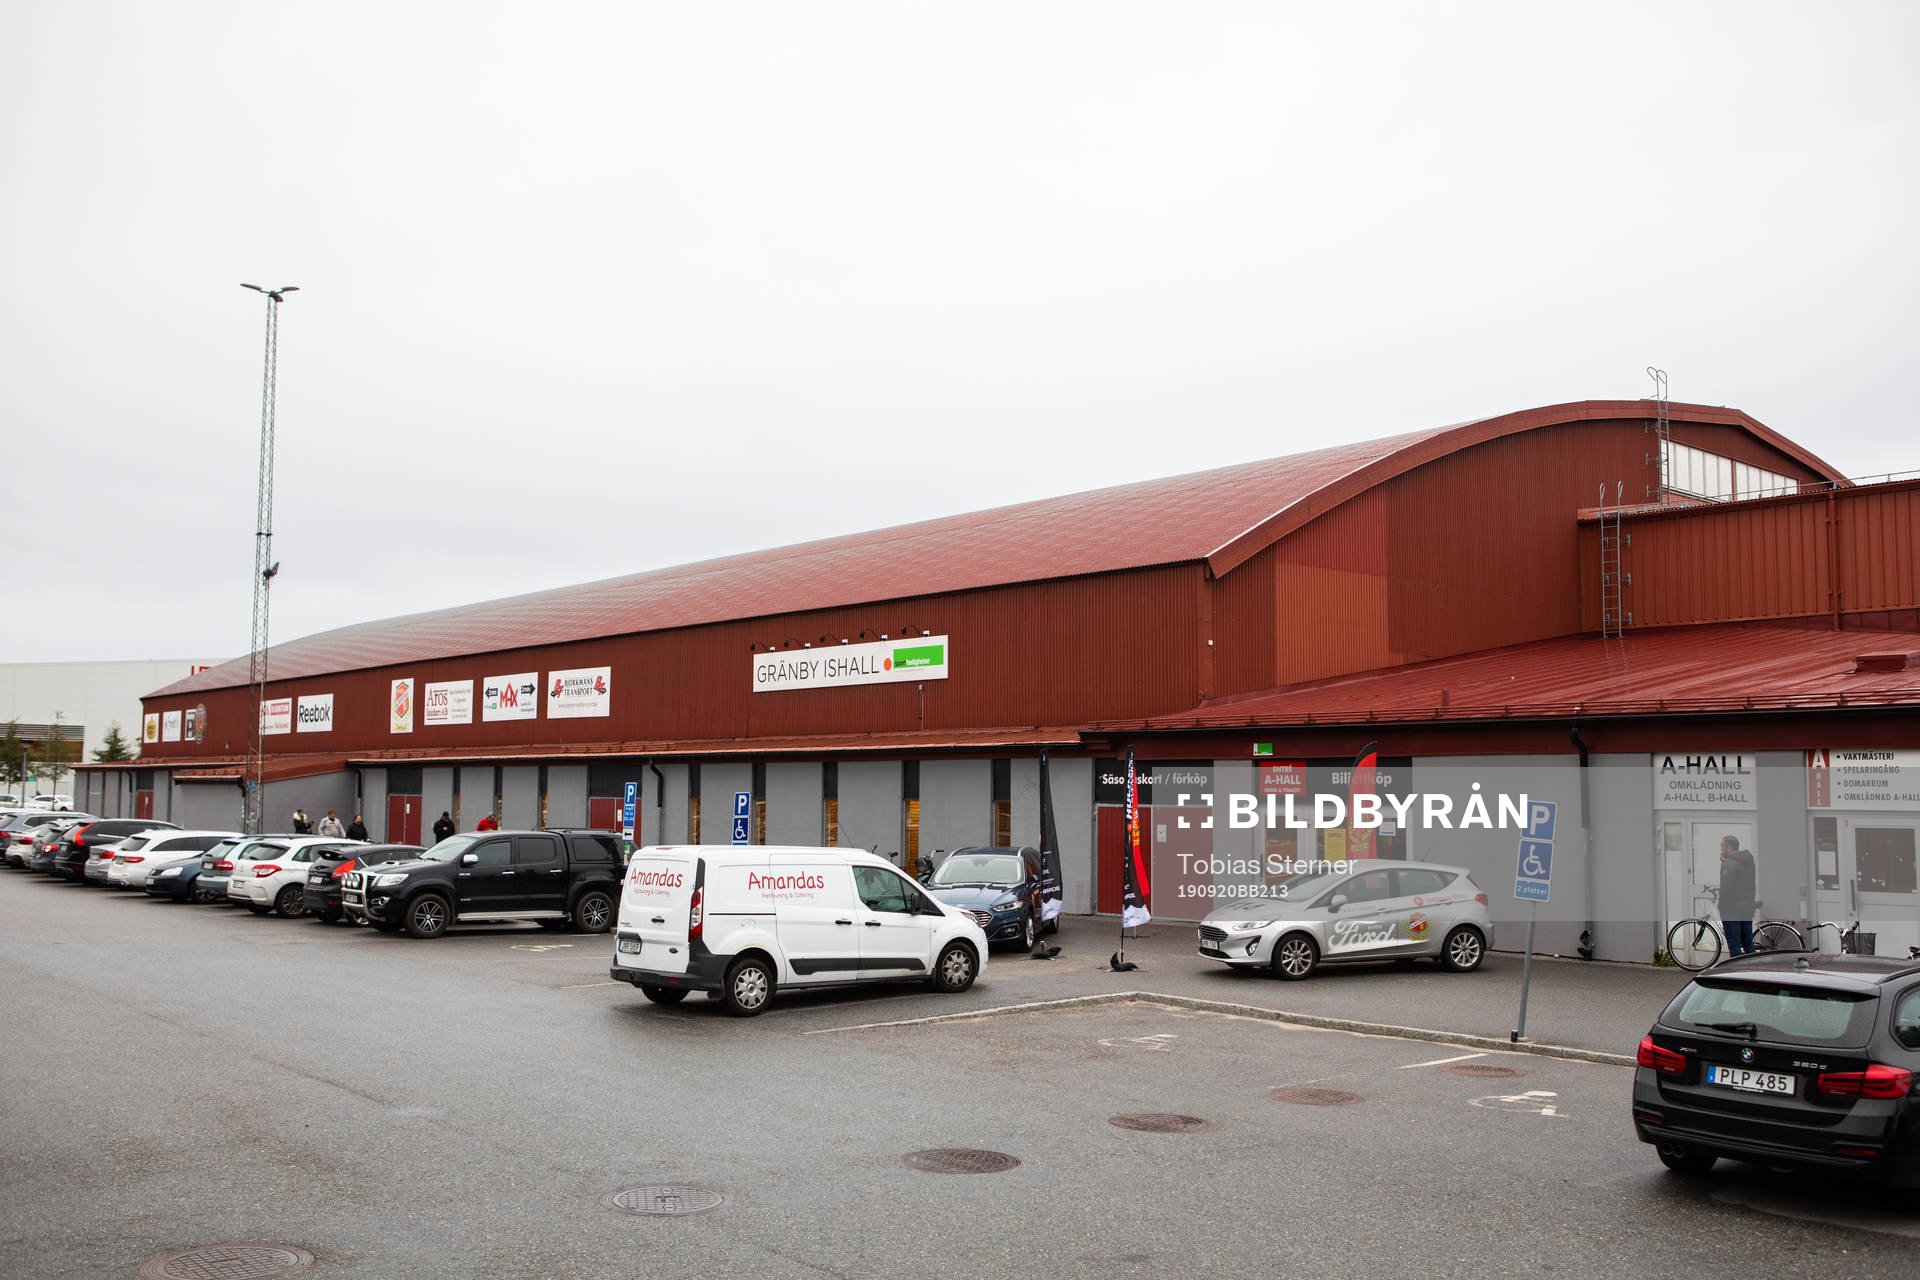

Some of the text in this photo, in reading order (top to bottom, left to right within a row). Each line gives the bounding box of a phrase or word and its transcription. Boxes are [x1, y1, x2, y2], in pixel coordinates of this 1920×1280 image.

[757, 655, 879, 683] GRÄNBY ISHALL
[426, 688, 448, 706] Aros
[500, 682, 518, 708] MAX
[299, 703, 330, 723] Reebok
[1812, 750, 1827, 769] A
[1843, 751, 1894, 760] VAKTMÄSTERI
[1272, 765, 1293, 773] ENTRÉ
[1660, 756, 1751, 775] A-HALL
[1843, 764, 1900, 774] SPELARINGÅNG
[1102, 773, 1162, 785] Säsoskort
[1172, 772, 1208, 787] förköp
[1264, 775, 1301, 785] A-HALL
[1669, 779, 1742, 790] OMKLÄDNING
[627, 785, 635, 802] P
[1663, 793, 1748, 803] A-HALL, B-HALL
[1844, 792, 1891, 801] OMKLÄDNAD
[737, 795, 747, 814] P
[1530, 805, 1550, 835] P
[630, 867, 683, 888] Amandas
[748, 871, 824, 890] Amandas
[1523, 887, 1547, 896] platser
[1327, 920, 1396, 951] Ford
[1720, 1069, 1751, 1085] PLP
[1755, 1074, 1788, 1091] 485
